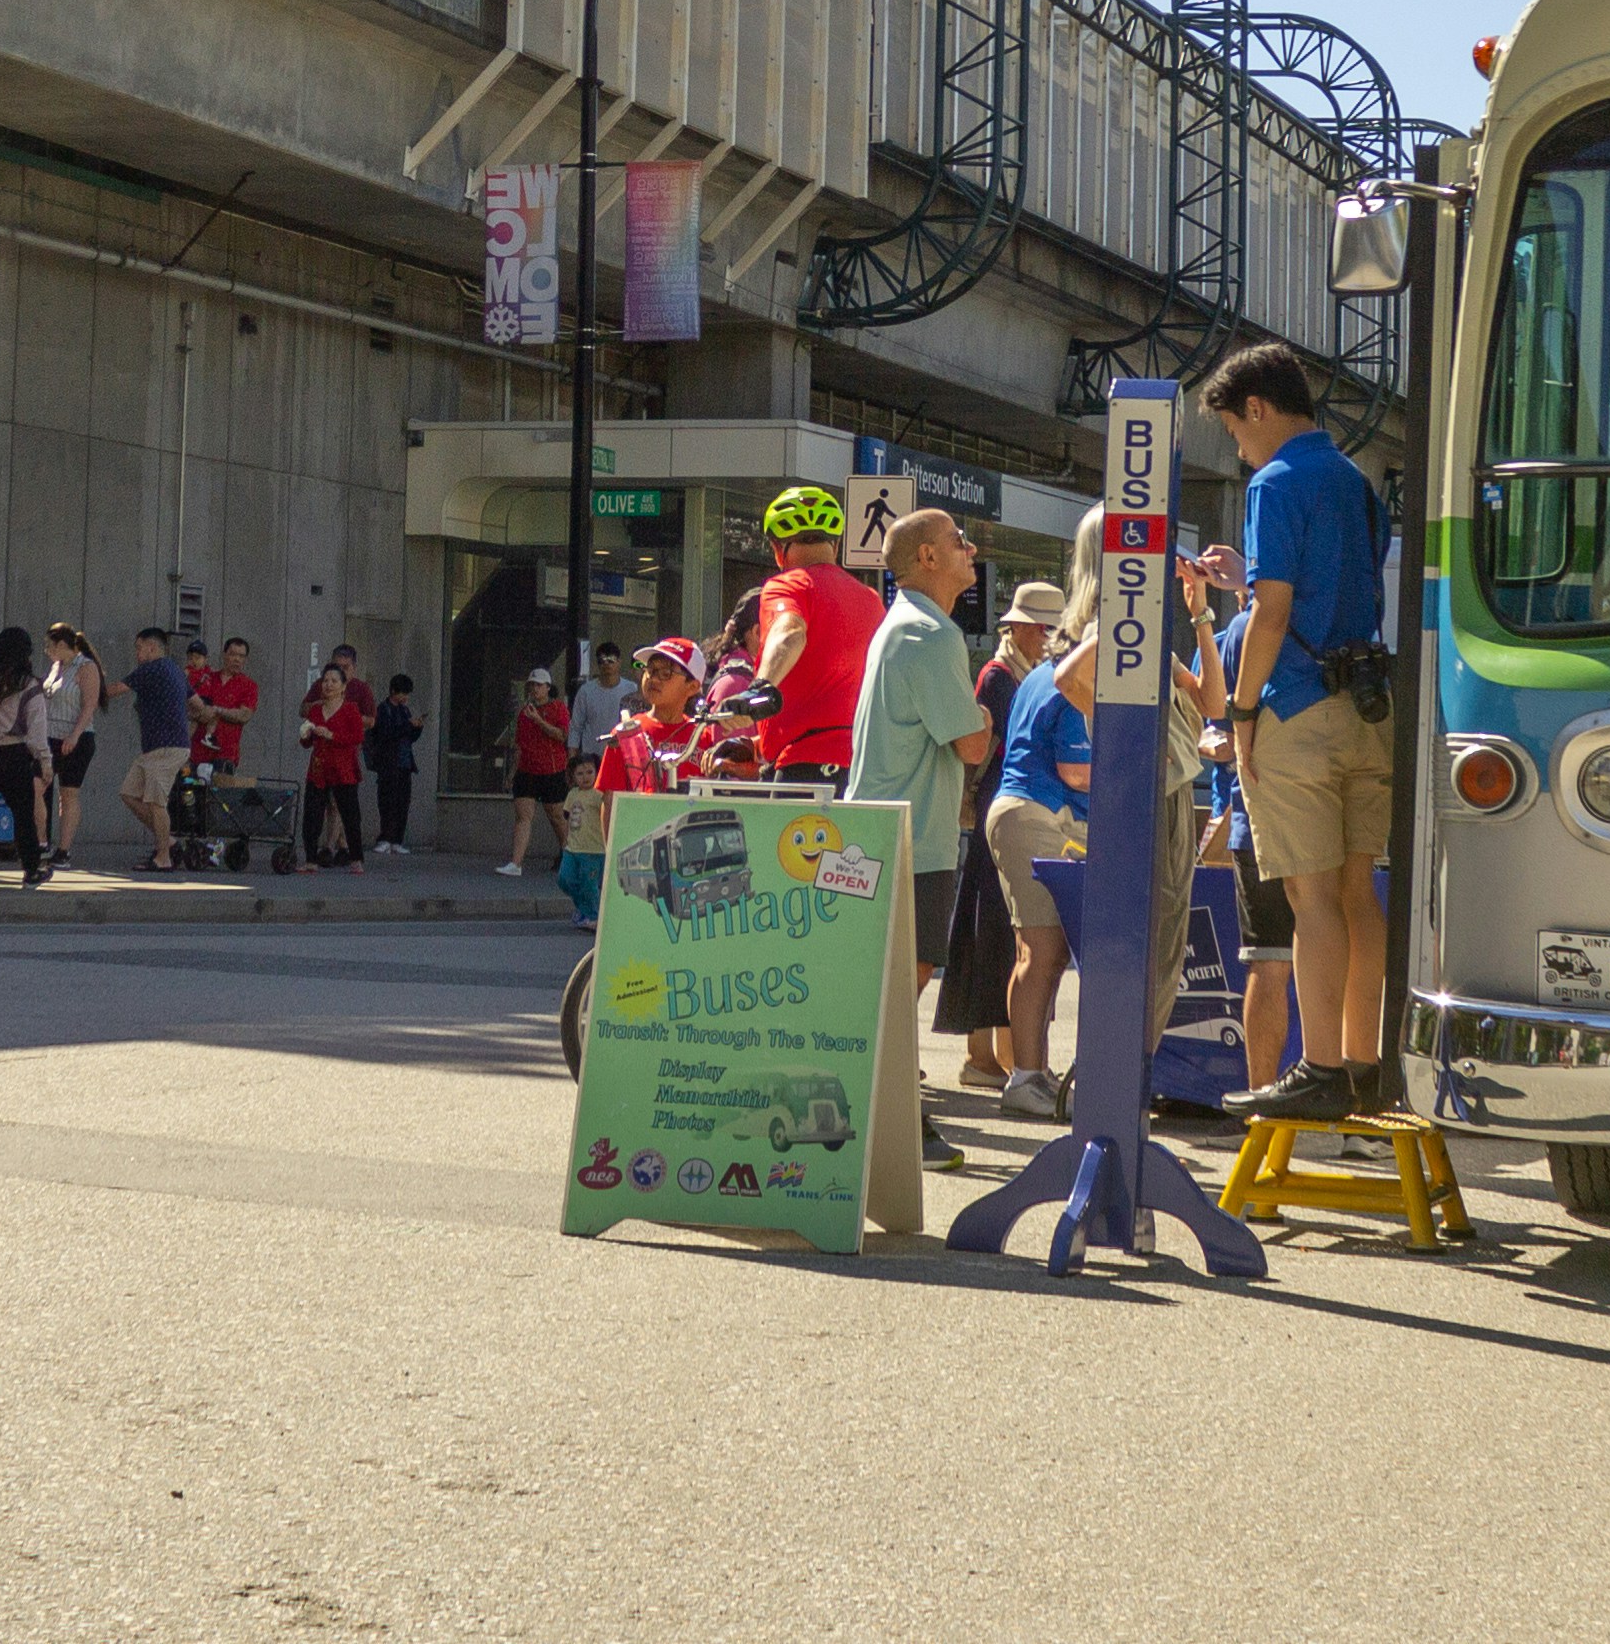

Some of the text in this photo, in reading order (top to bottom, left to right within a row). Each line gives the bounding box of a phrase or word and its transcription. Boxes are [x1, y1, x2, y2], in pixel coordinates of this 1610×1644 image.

[1121, 419, 1153, 509] BUS
[902, 458, 985, 505] Patterson Station
[597, 494, 635, 514] OLIVE
[1112, 558, 1148, 677] STOP
[822, 871, 870, 891] OPEN
[835, 863, 865, 876] We're
[656, 884, 839, 944] Vintage
[616, 984, 659, 1002] Admission!
[626, 978, 644, 990] Free
[665, 962, 810, 1021] Buses
[1553, 987, 1600, 1001] BRITISH
[596, 1019, 868, 1054] Transit: Through The Years
[657, 1057, 728, 1084] Display
[653, 1083, 771, 1109] Memorabilia
[650, 1109, 716, 1132] Photos
[785, 1189, 854, 1202] TRANS LINK
